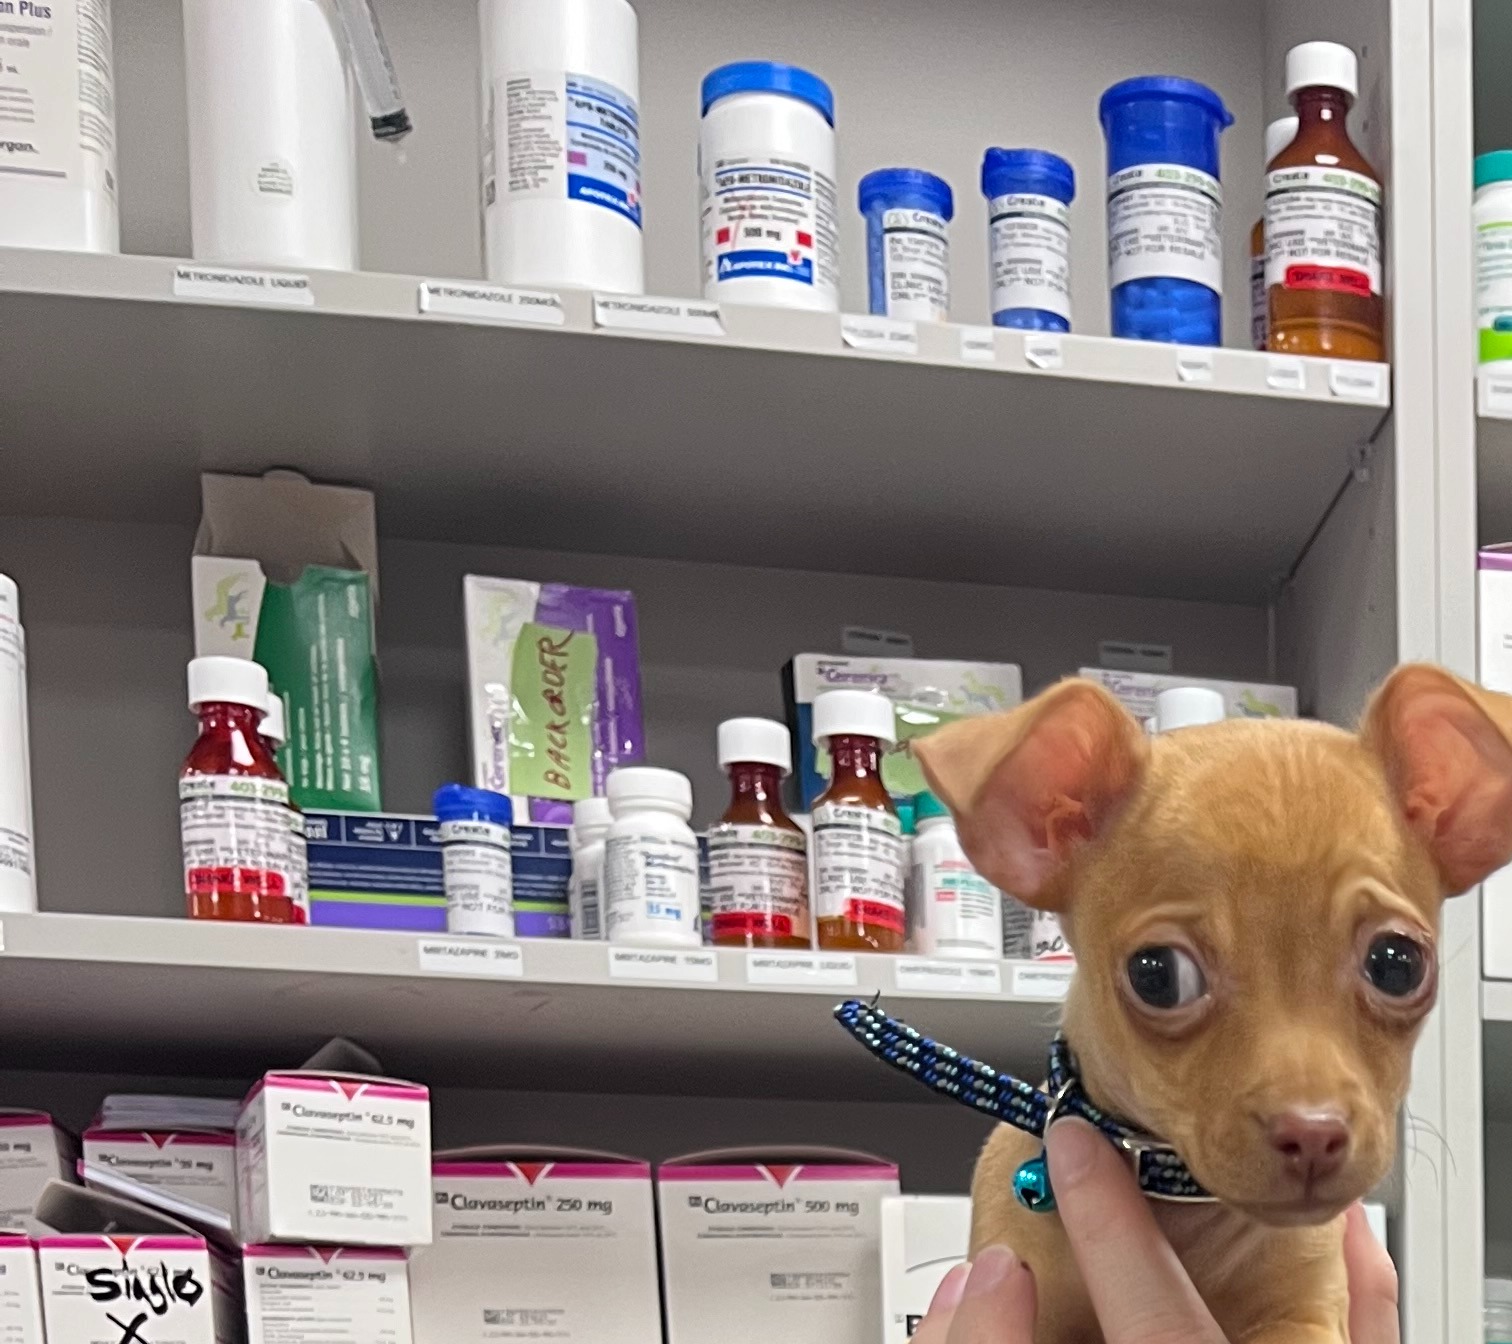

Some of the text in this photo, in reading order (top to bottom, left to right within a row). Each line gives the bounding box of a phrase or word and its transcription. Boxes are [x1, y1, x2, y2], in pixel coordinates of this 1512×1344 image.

[19, 1, 52, 18] Plus
[450, 1194, 613, 1217] Clavaseptin 250 mg
[703, 1197, 860, 1217] Clavaseptin 500 mg
